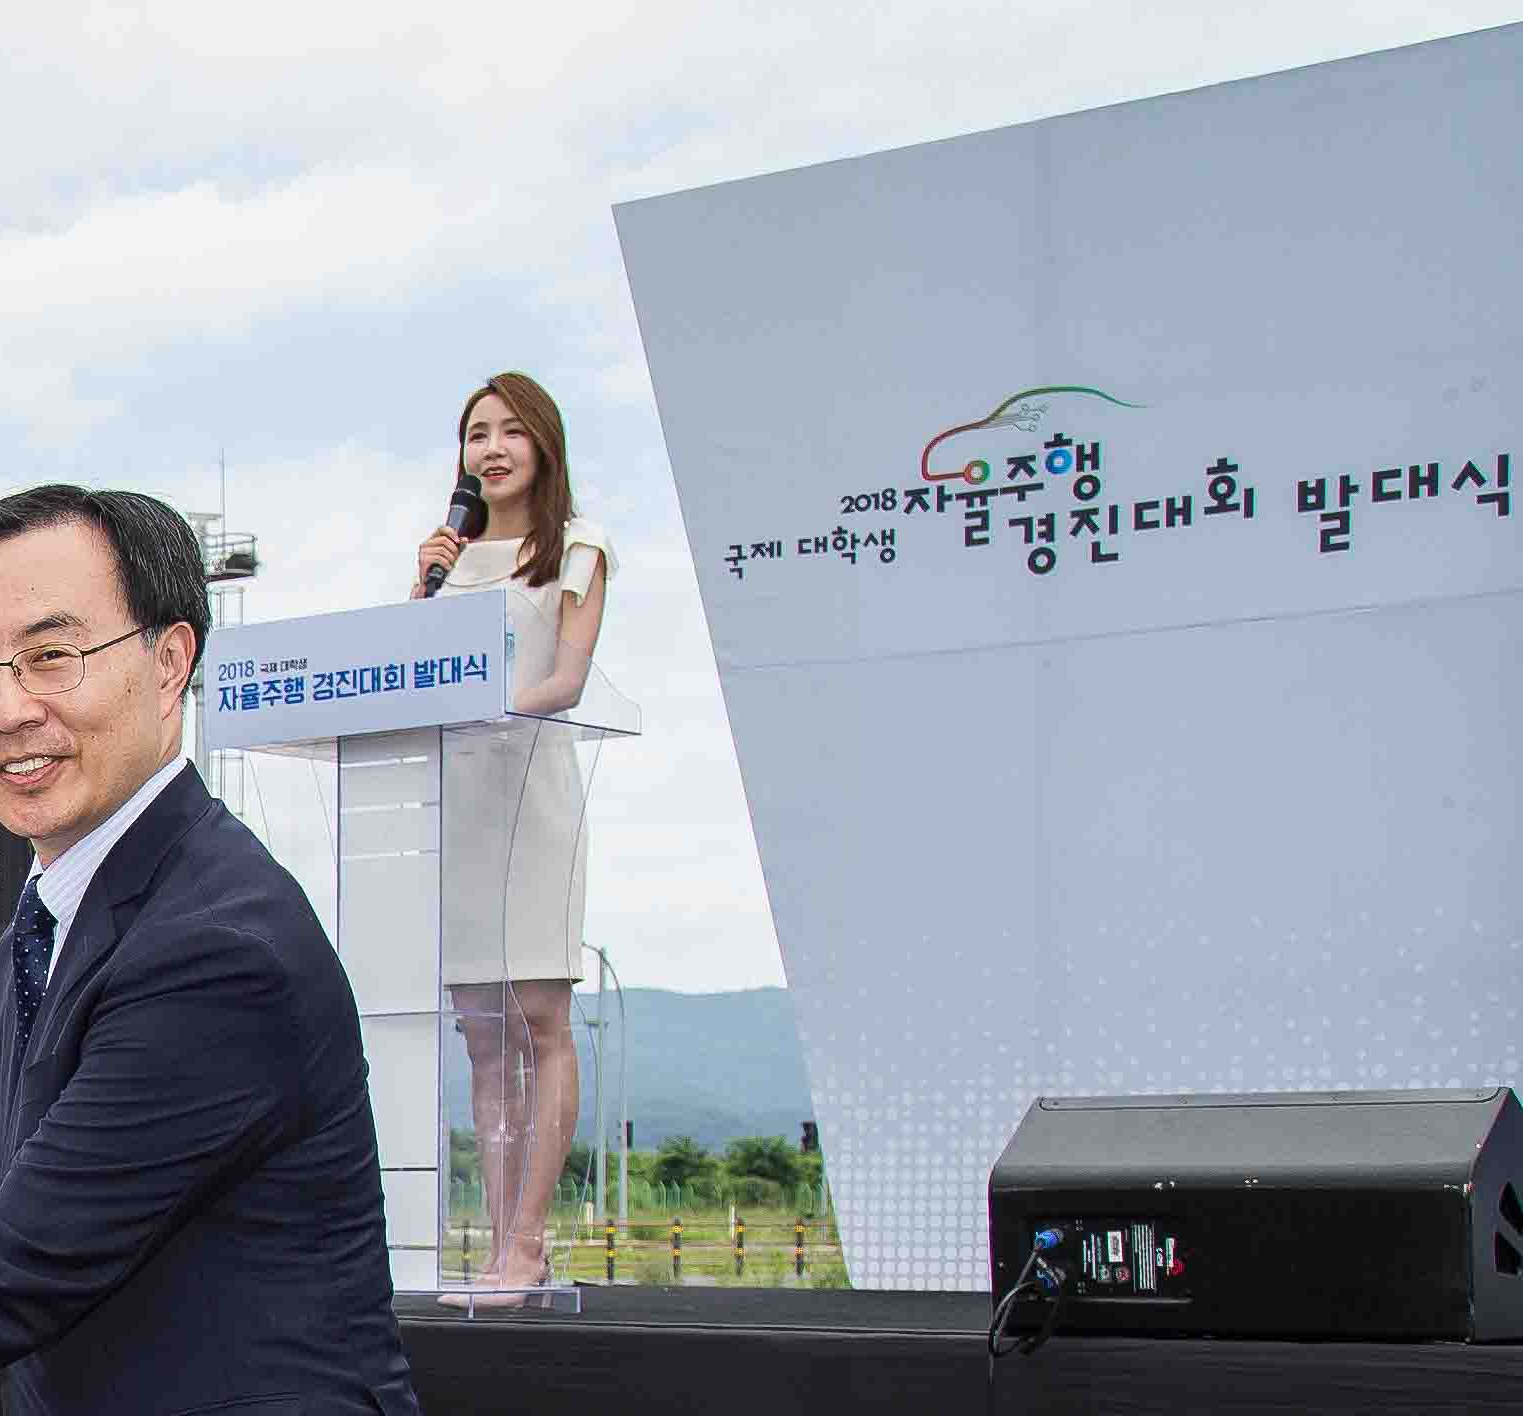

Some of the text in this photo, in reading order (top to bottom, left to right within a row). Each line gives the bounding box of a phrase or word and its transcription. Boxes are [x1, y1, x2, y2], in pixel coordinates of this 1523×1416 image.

[724, 453, 1511, 579] 국제 대학생 경진대회 발대식
[840, 431, 1101, 548] 2018 자율주행
[218, 660, 255, 682] 2018
[218, 653, 487, 712] 자율주행 경진대회 발대식
